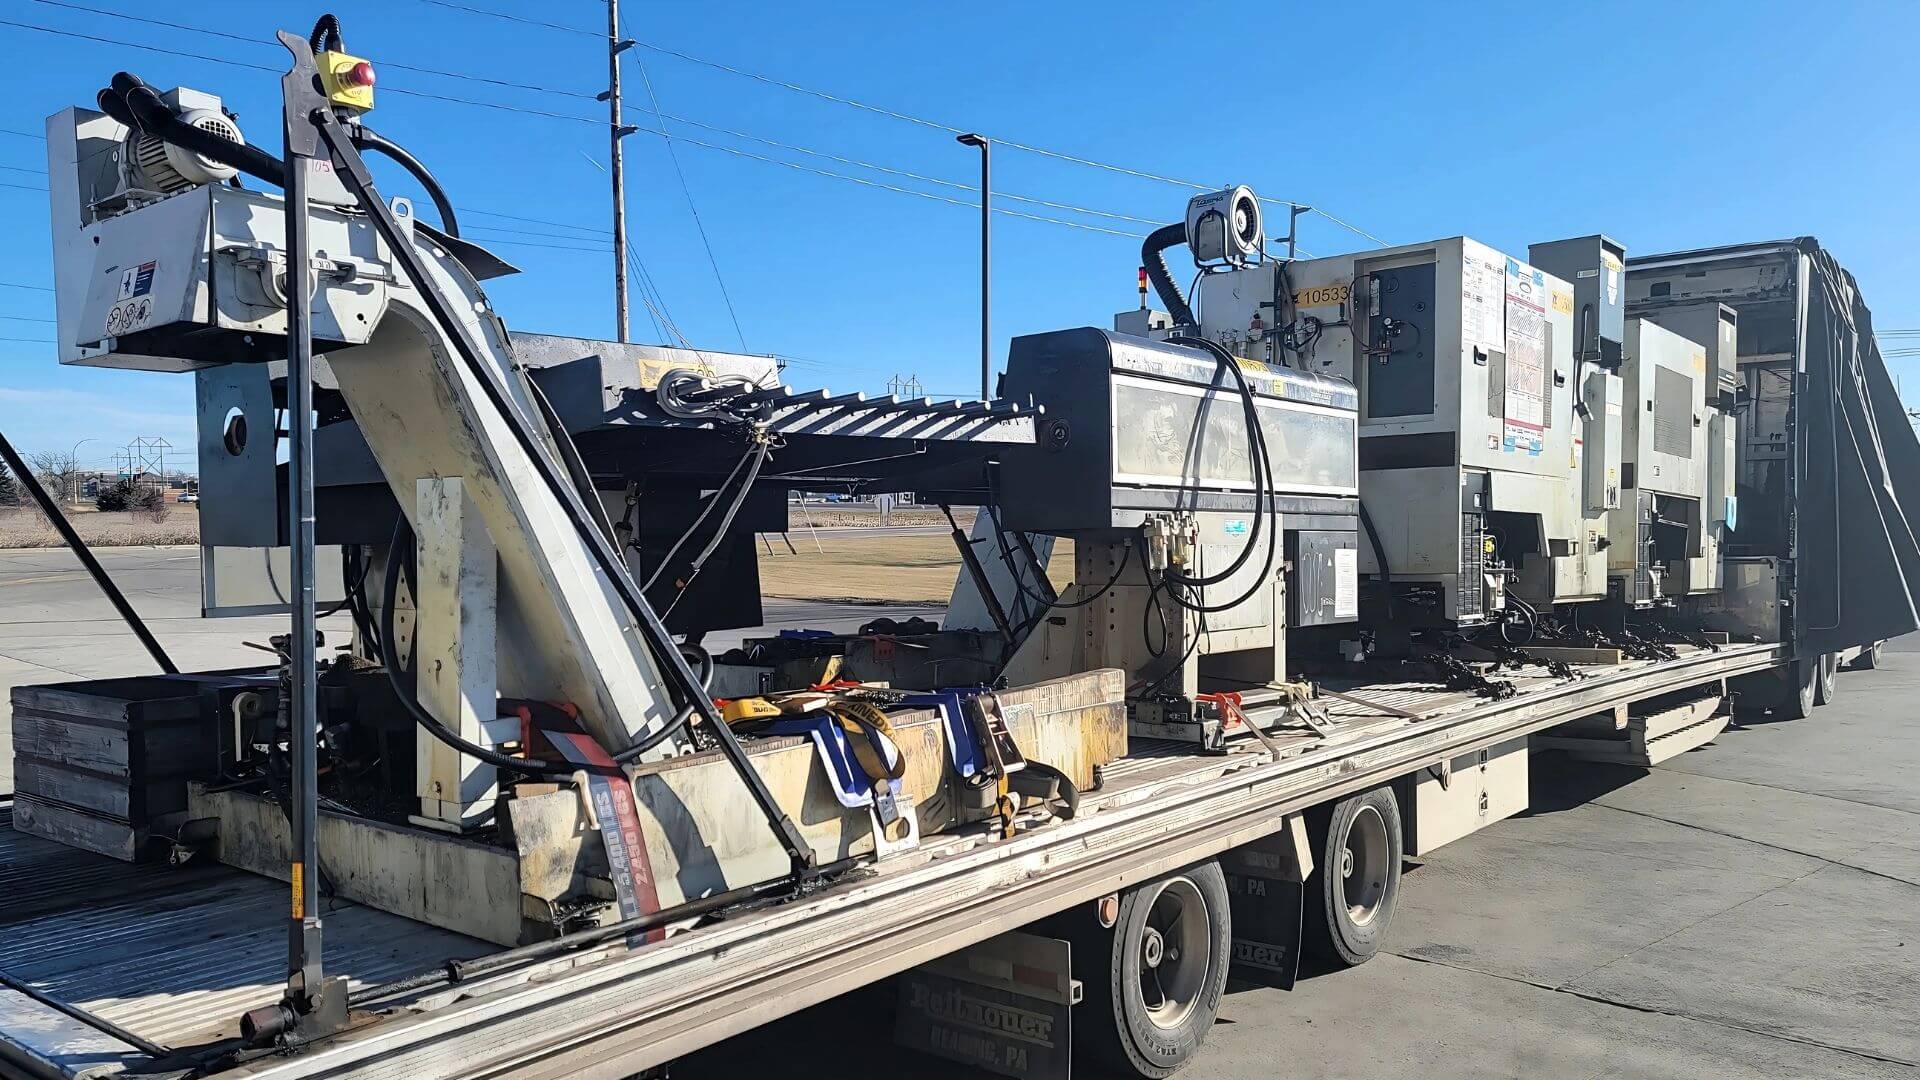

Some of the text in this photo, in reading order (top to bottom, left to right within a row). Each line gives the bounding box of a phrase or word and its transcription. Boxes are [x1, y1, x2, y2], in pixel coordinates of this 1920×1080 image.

[1304, 286, 1349, 304] 10533
[1247, 878, 1266, 896] PA
[1005, 1045, 1028, 1071] PA
